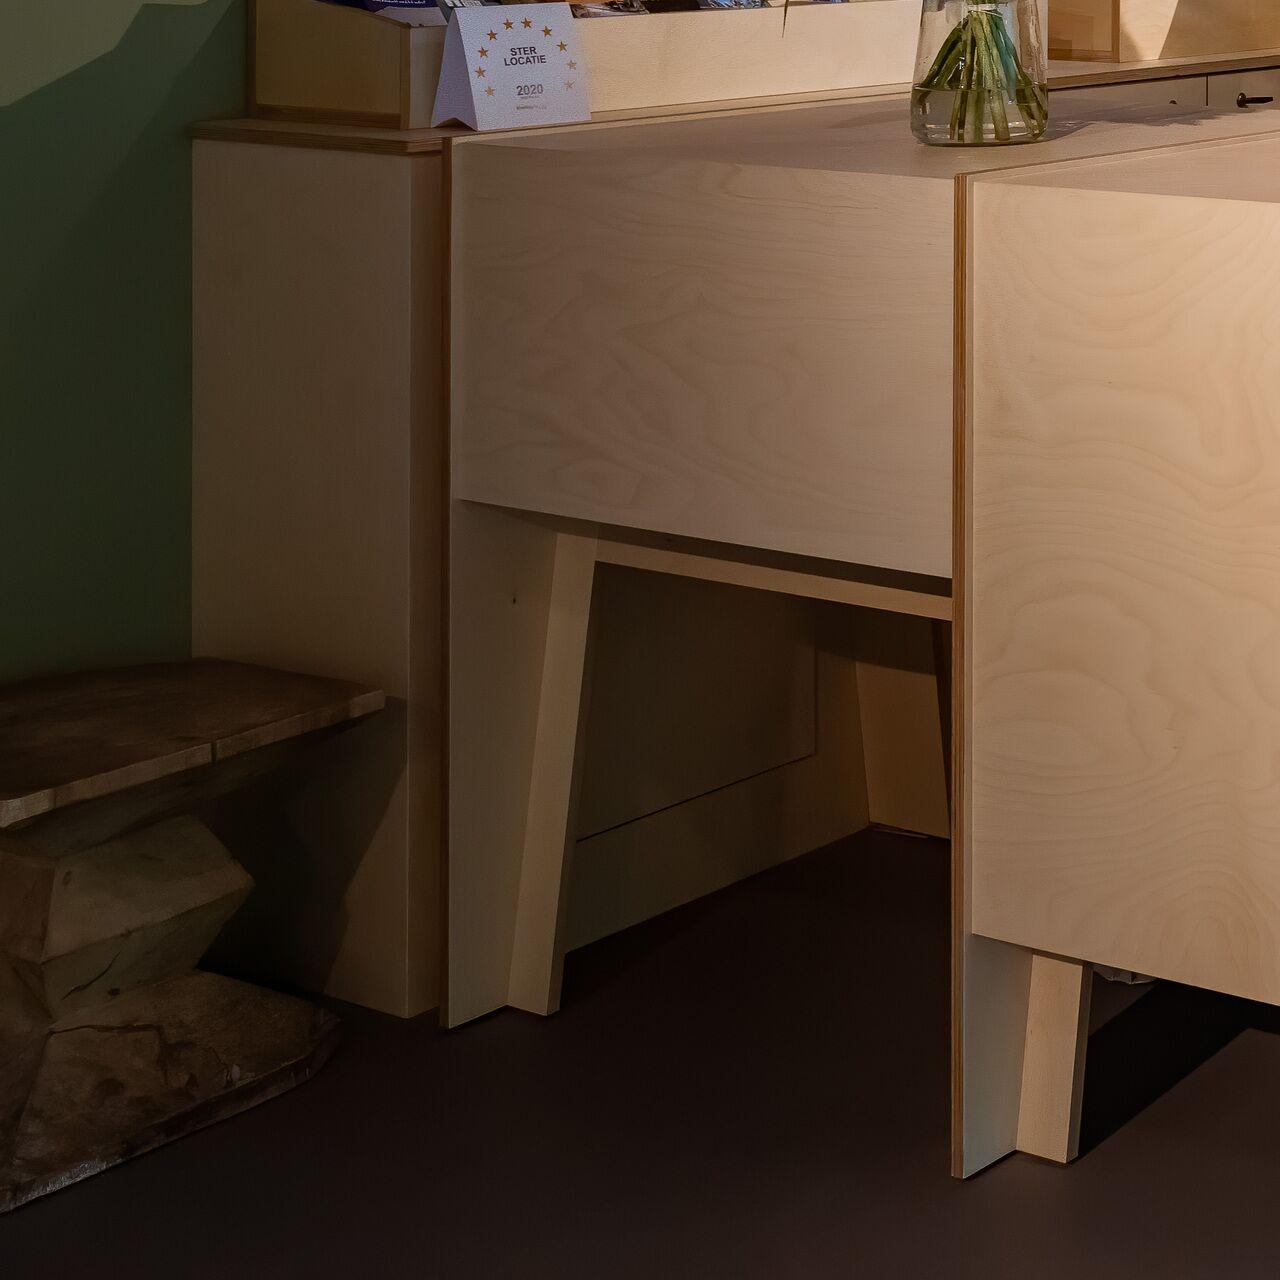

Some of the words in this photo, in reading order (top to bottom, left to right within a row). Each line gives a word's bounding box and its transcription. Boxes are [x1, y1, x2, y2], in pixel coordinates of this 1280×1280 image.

[510, 46, 537, 56] STER
[503, 55, 547, 66] LOCATIE
[516, 84, 544, 96] 2020
